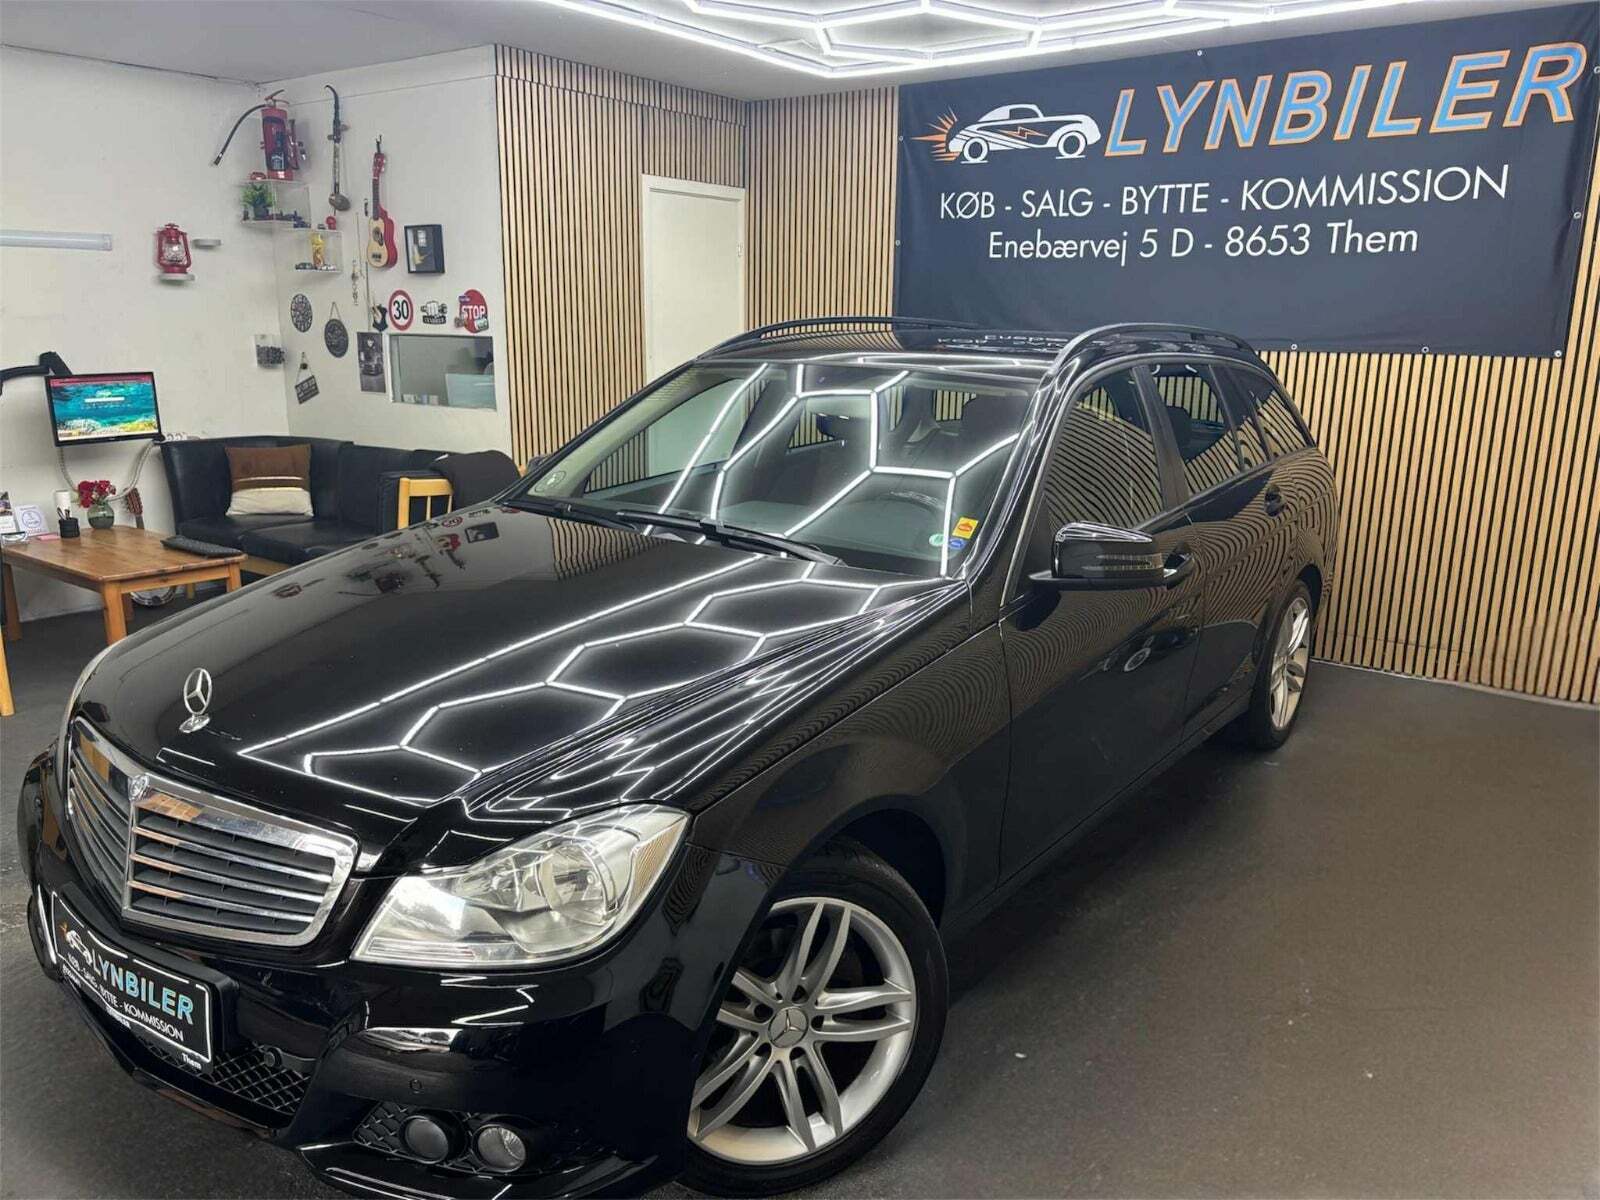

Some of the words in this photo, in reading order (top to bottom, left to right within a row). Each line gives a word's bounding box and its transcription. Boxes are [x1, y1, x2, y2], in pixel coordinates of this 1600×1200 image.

[1105, 42, 1588, 158] LYNBILER
[940, 189, 996, 220] KØB
[1020, 188, 1094, 219] SALG
[1121, 182, 1210, 217] BYTTE
[1240, 163, 1509, 212] KOMMISSION
[988, 228, 1127, 267] Enebærvej
[1138, 228, 1159, 258] 5
[1171, 227, 1194, 258] D
[1224, 221, 1311, 257] 8653
[1326, 219, 1419, 254] Them
[393, 299, 410, 320] 30
[461, 304, 487, 320] STOP
[92, 948, 194, 1025] LYNBILER
[124, 1001, 185, 1042] KOMMISSION
[182, 1052, 202, 1071] Them
